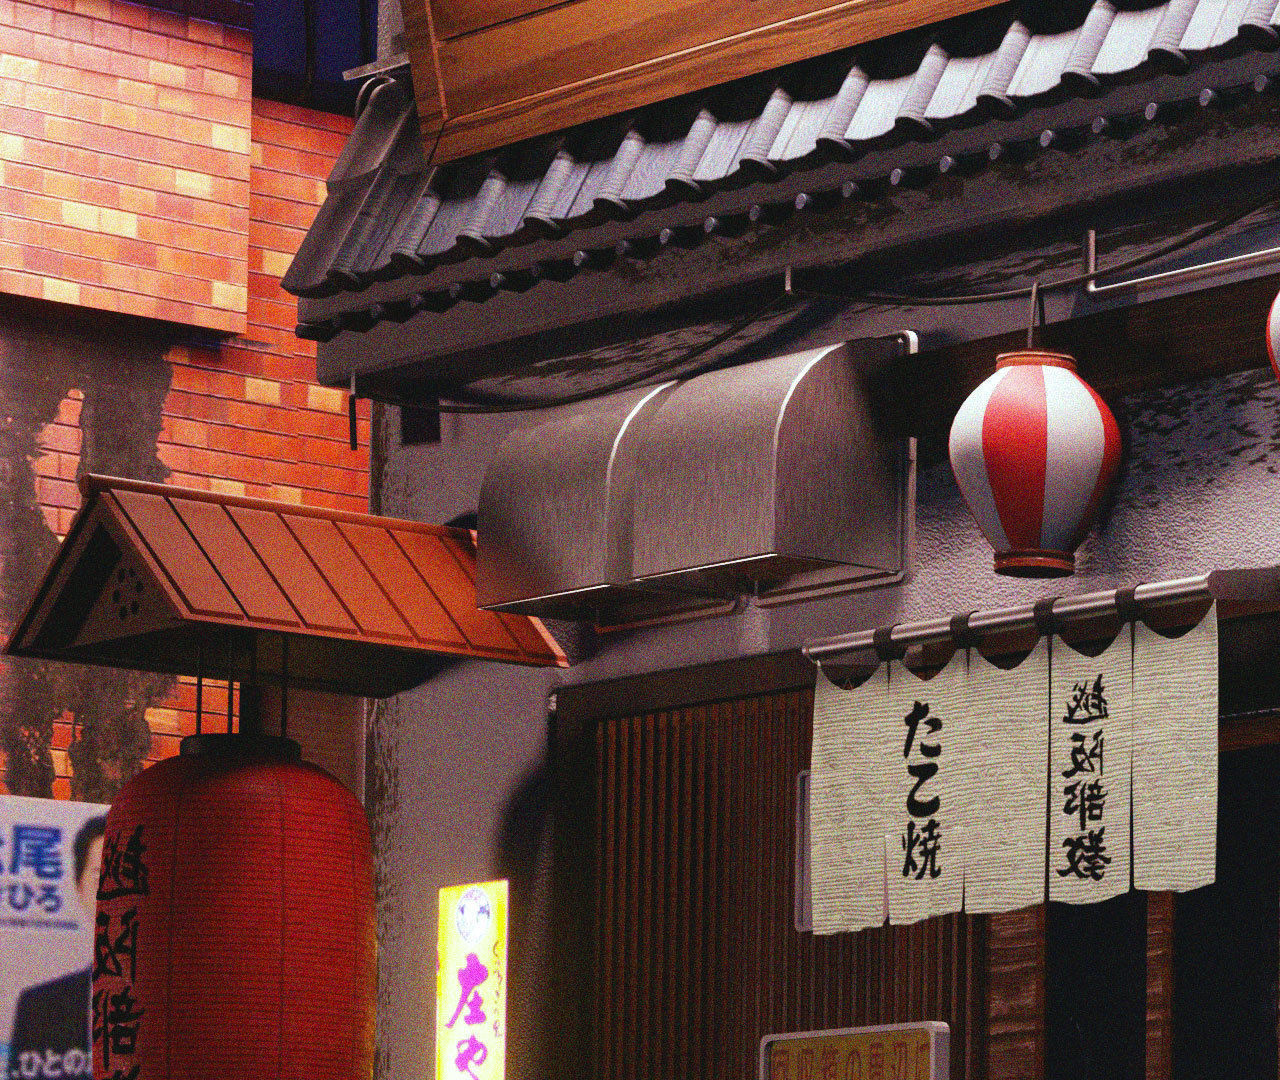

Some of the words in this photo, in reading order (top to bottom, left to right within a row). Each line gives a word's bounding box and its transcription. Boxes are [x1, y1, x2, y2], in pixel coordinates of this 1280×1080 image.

[903, 700, 943, 881] たこ焼
[0, 823, 63, 879] 尾
